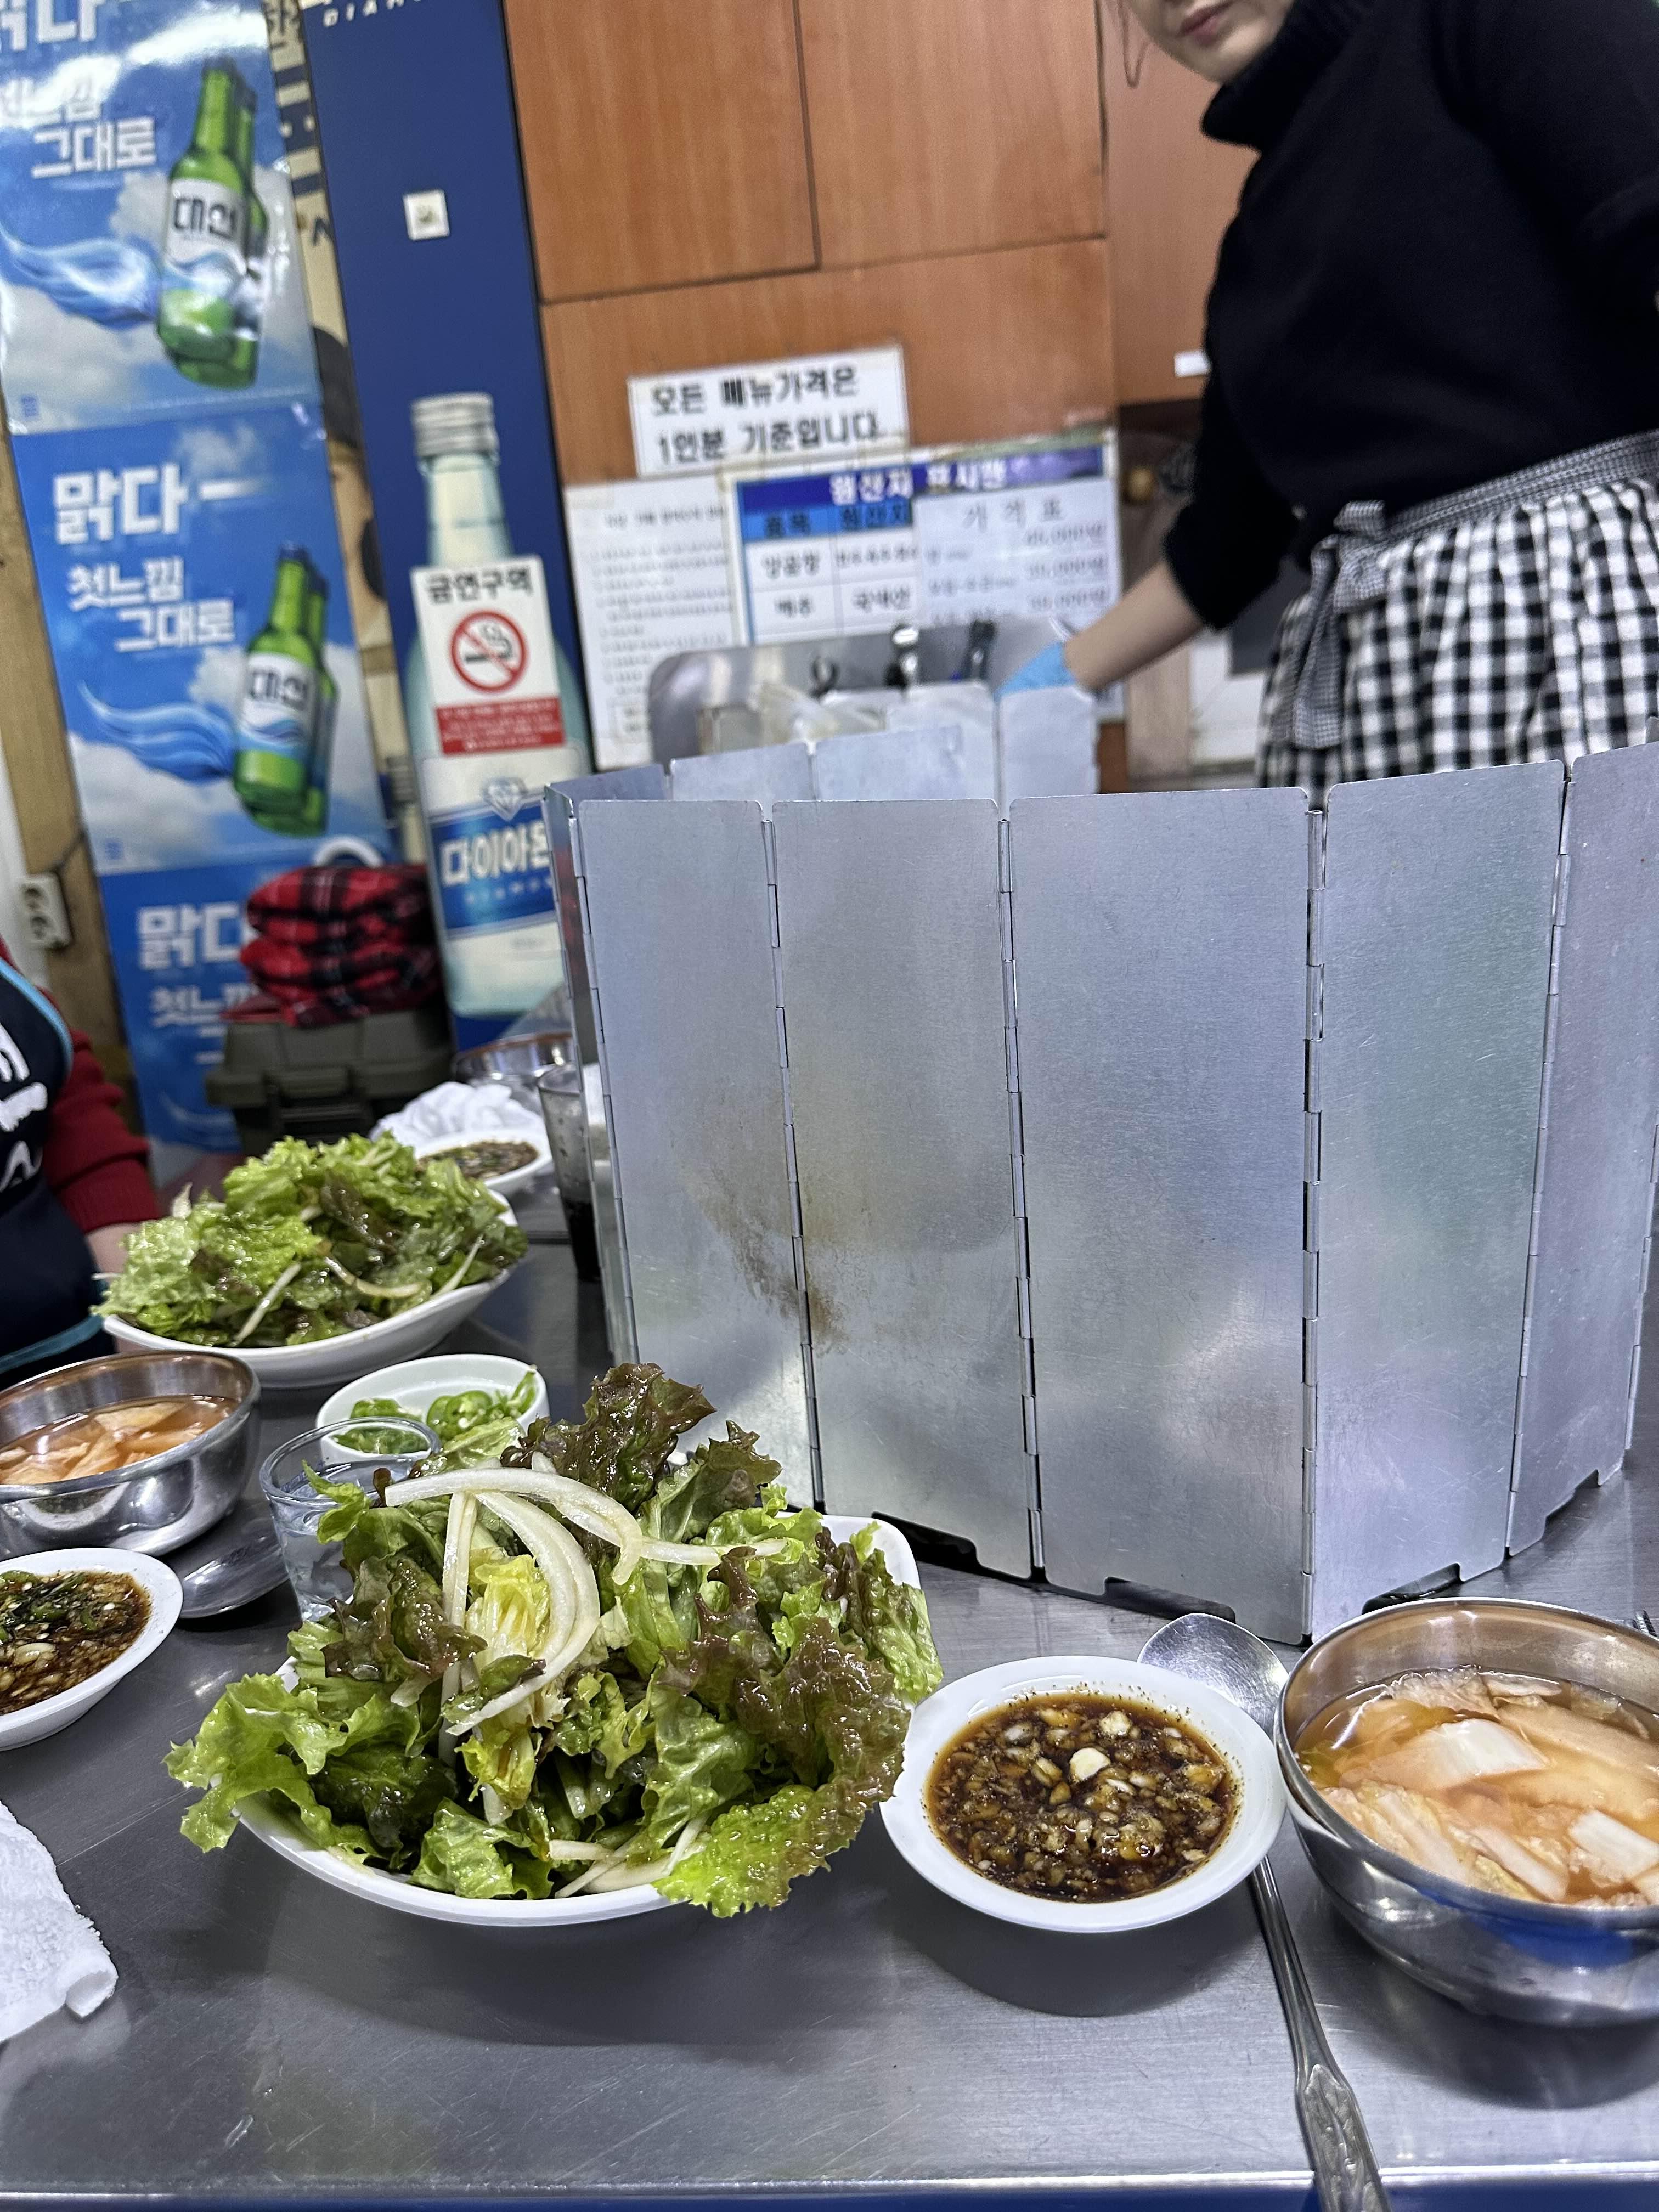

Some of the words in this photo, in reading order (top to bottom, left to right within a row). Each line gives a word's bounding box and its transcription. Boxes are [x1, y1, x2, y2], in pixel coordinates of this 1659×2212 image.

[31, 116, 156, 179] 그대로
[653, 381, 706, 416] 모든
[720, 365, 860, 407] 메뉴가격은
[659, 428, 725, 465] 1인분
[741, 409, 879, 454] 기준입니다
[54, 462, 189, 545] 맑다
[68, 555, 184, 611] 첫느낌
[426, 565, 534, 605] 금연구역
[115, 599, 235, 653] 그대로
